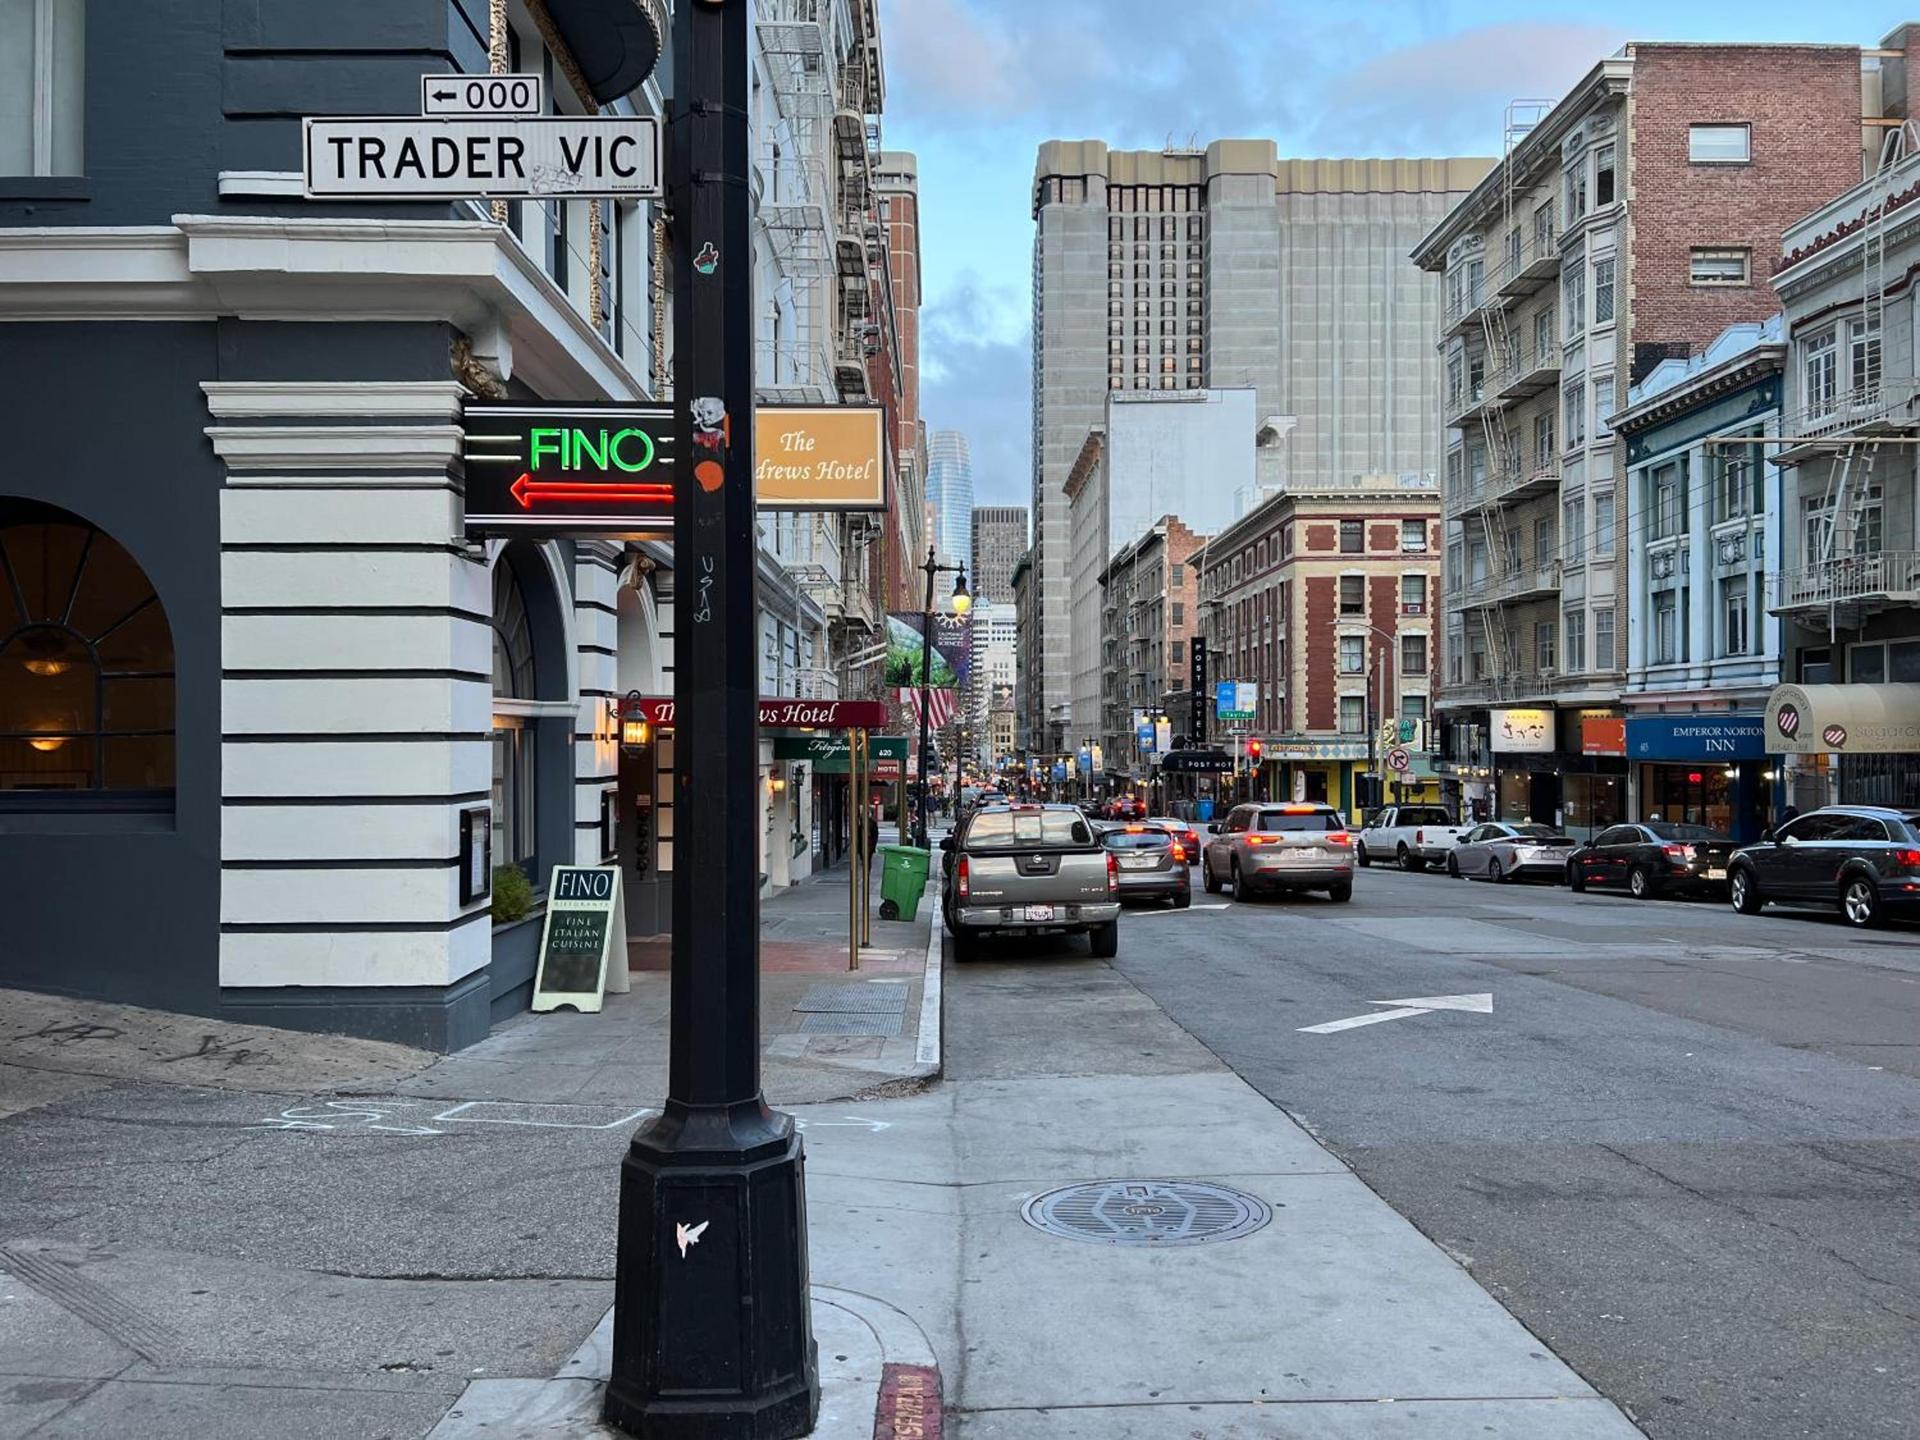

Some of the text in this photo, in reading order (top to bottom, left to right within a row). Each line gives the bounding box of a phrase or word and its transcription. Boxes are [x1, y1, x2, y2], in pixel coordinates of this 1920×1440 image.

[466, 82, 529, 109] 000
[328, 136, 637, 179] TRADER VIC
[531, 428, 654, 472] FINO
[780, 430, 815, 452] The
[755, 459, 875, 480] drews Hotel
[781, 703, 839, 723] Hotel
[1673, 727, 1721, 737] EMPEROR
[1706, 739, 1735, 752] INN
[560, 873, 609, 897] FINO
[566, 918, 591, 926] FINE
[554, 929, 600, 937] ITALIAN
[552, 940, 601, 949] CUISINE
